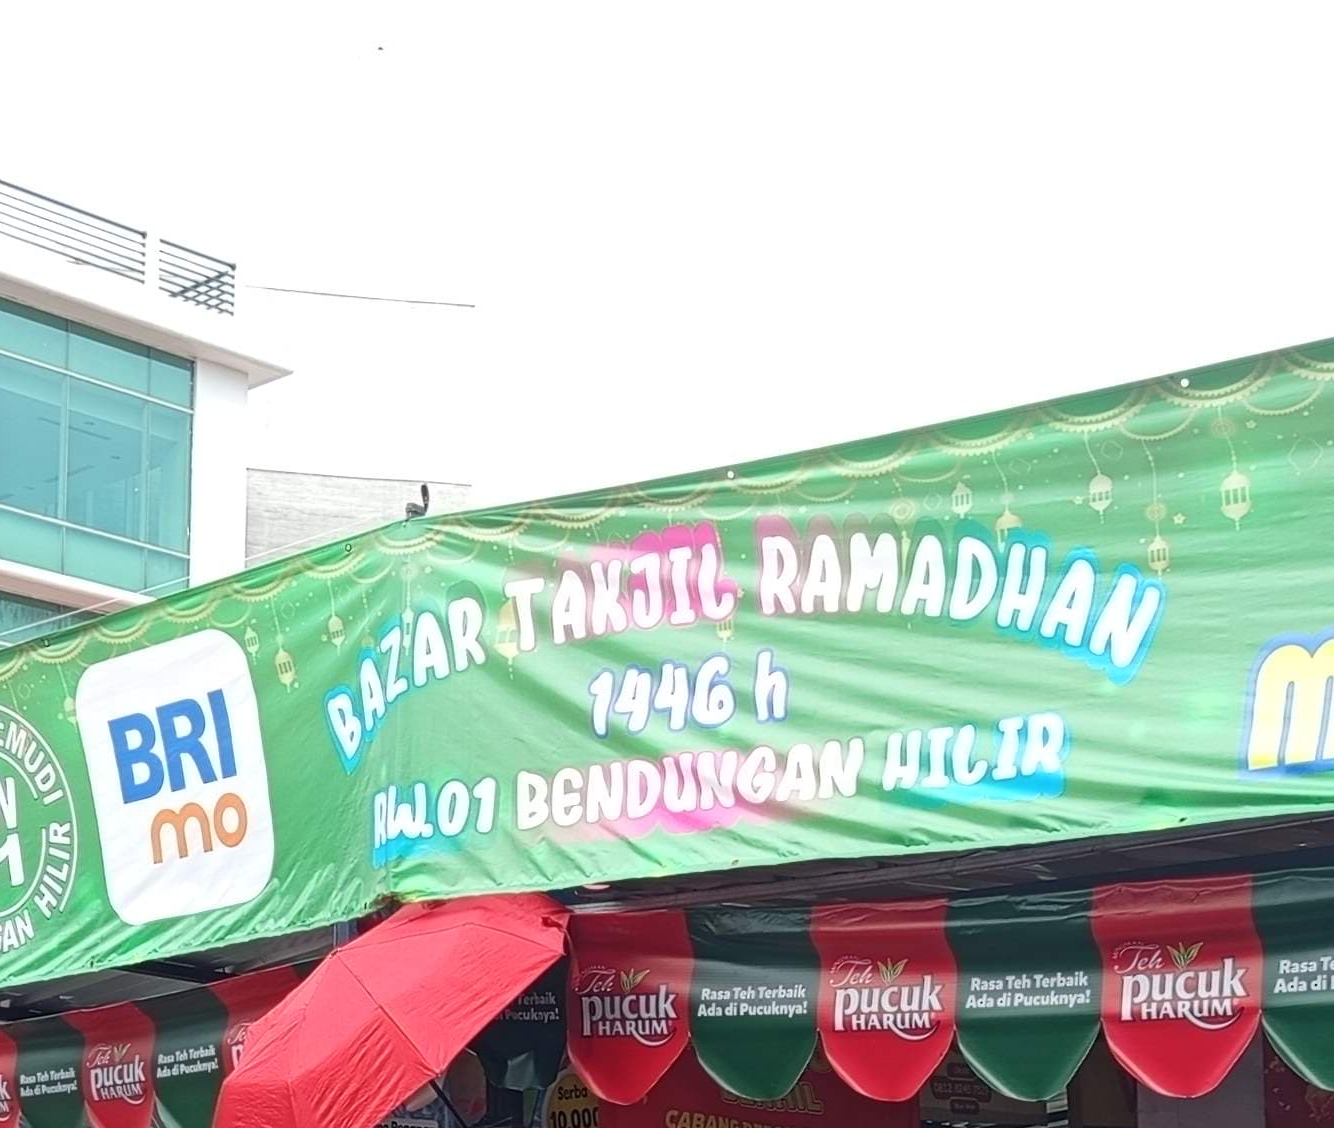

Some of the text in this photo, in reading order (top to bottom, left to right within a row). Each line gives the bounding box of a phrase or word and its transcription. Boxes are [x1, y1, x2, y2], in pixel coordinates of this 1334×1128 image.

[328, 533, 1161, 762] BAZAR TAKJIL RAMADHAN
[589, 654, 737, 737] 1446
[107, 687, 237, 804] BRI
[515, 737, 865, 833] BENDUNGAN
[883, 714, 1066, 790] HILIR
[149, 791, 249, 865] mo
[33, 821, 71, 920] HILIR
[830, 958, 875, 987] Teh
[1114, 945, 1166, 975] Teh
[1279, 956, 1318, 974] Rasa
[575, 969, 616, 994] Teh
[701, 984, 806, 1000] Rasa Teh Terbaik
[970, 972, 1088, 991] Rasa Teh Terbaik
[1120, 957, 1248, 1021] pucuk
[1274, 974, 1307, 993] Ada
[1309, 973, 1327, 991] di
[582, 985, 677, 1036] pucuk
[698, 1001, 808, 1018] Ada di Pucuknya!
[834, 975, 943, 1031] pucuk
[965, 990, 1091, 1009] Ada di Pucuknya!
[1141, 996, 1237, 1021] HARUM
[598, 1020, 670, 1042] HARUM
[852, 1013, 933, 1034] HARUM
[158, 1045, 216, 1065] Rasa Teh Terbaik
[91, 1055, 145, 1101] pucuk
[156, 1066, 171, 1079] Ada
[100, 1083, 143, 1100] HARUM
[557, 1084, 588, 1100] Serba
